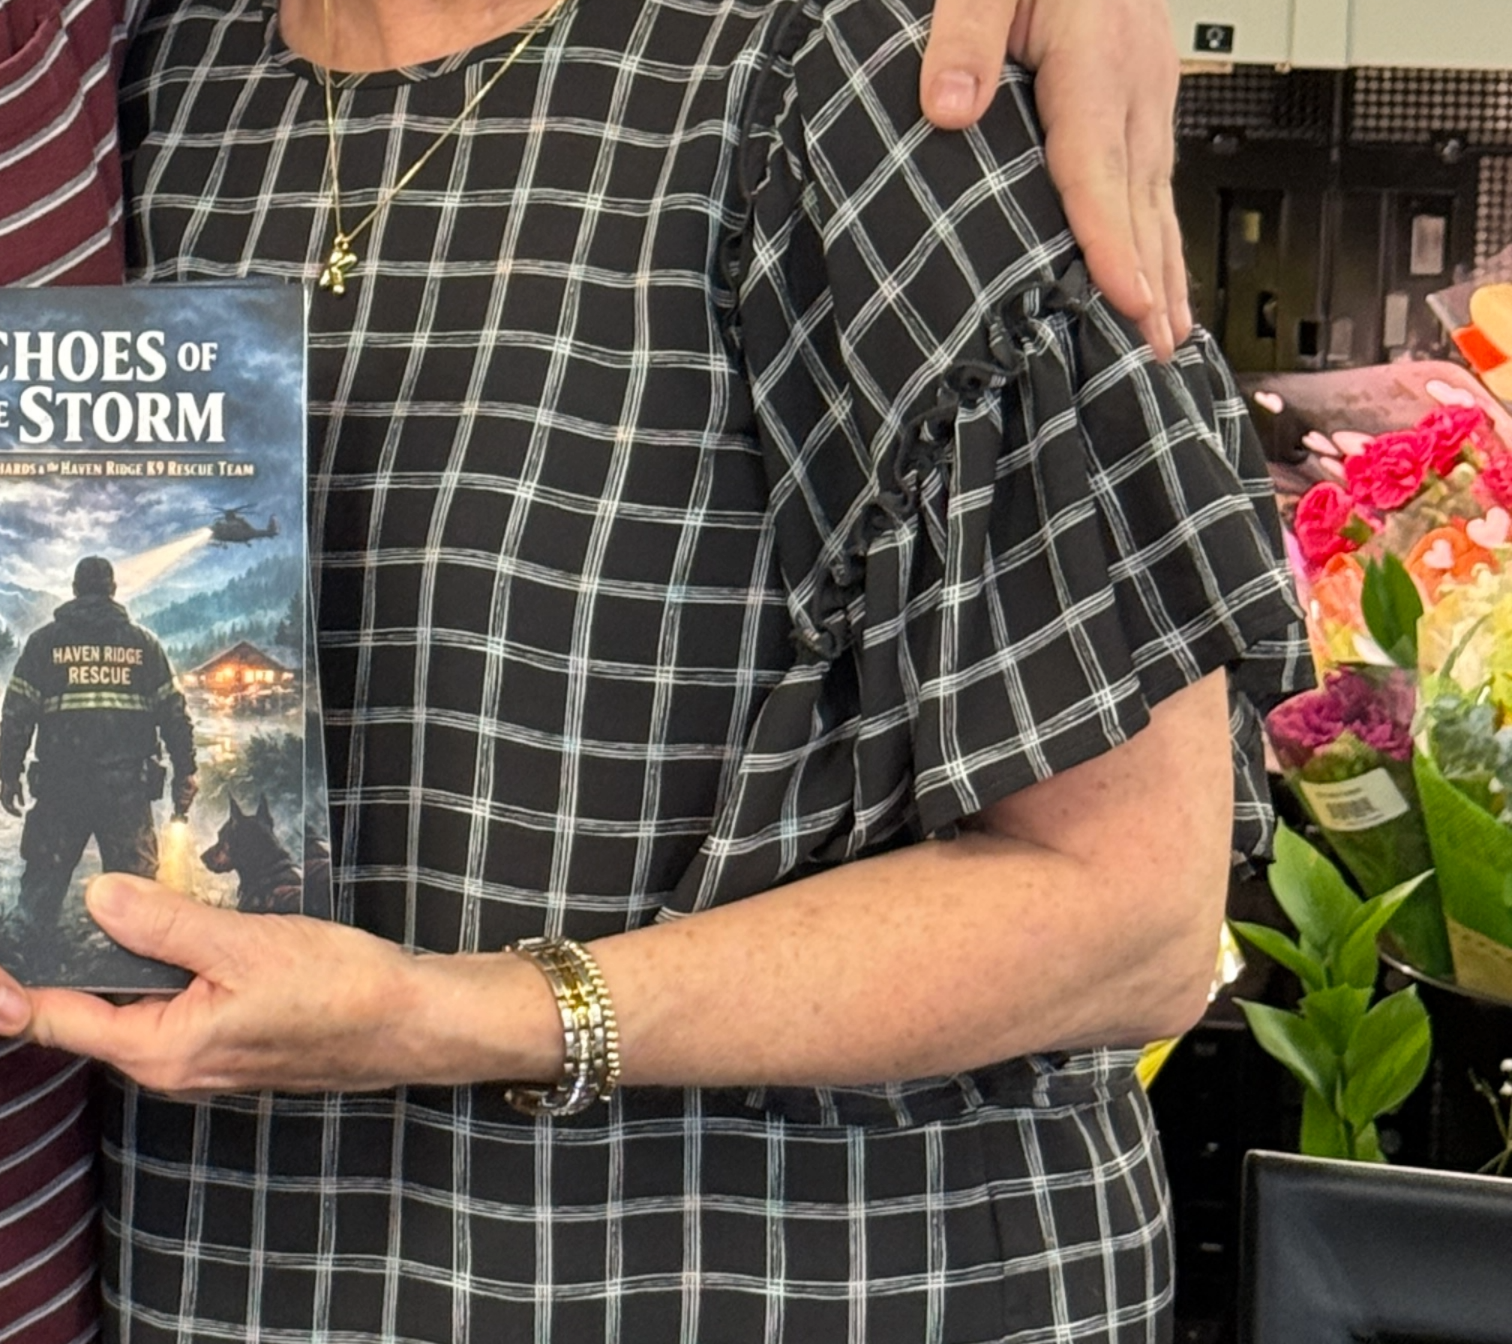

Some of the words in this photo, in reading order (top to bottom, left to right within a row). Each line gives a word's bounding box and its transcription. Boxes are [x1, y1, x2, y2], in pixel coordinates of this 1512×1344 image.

[177, 342, 218, 371] OF
[19, 385, 226, 444] STORM
[60, 460, 102, 476] HAVEN
[105, 461, 143, 476] RIDGE
[146, 461, 165, 476] K9
[167, 461, 214, 476] RESCUE
[217, 461, 254, 476] TEAM
[52, 645, 100, 665] HAVEN
[104, 645, 144, 665] RIDGE
[68, 666, 132, 685] RESCUE
